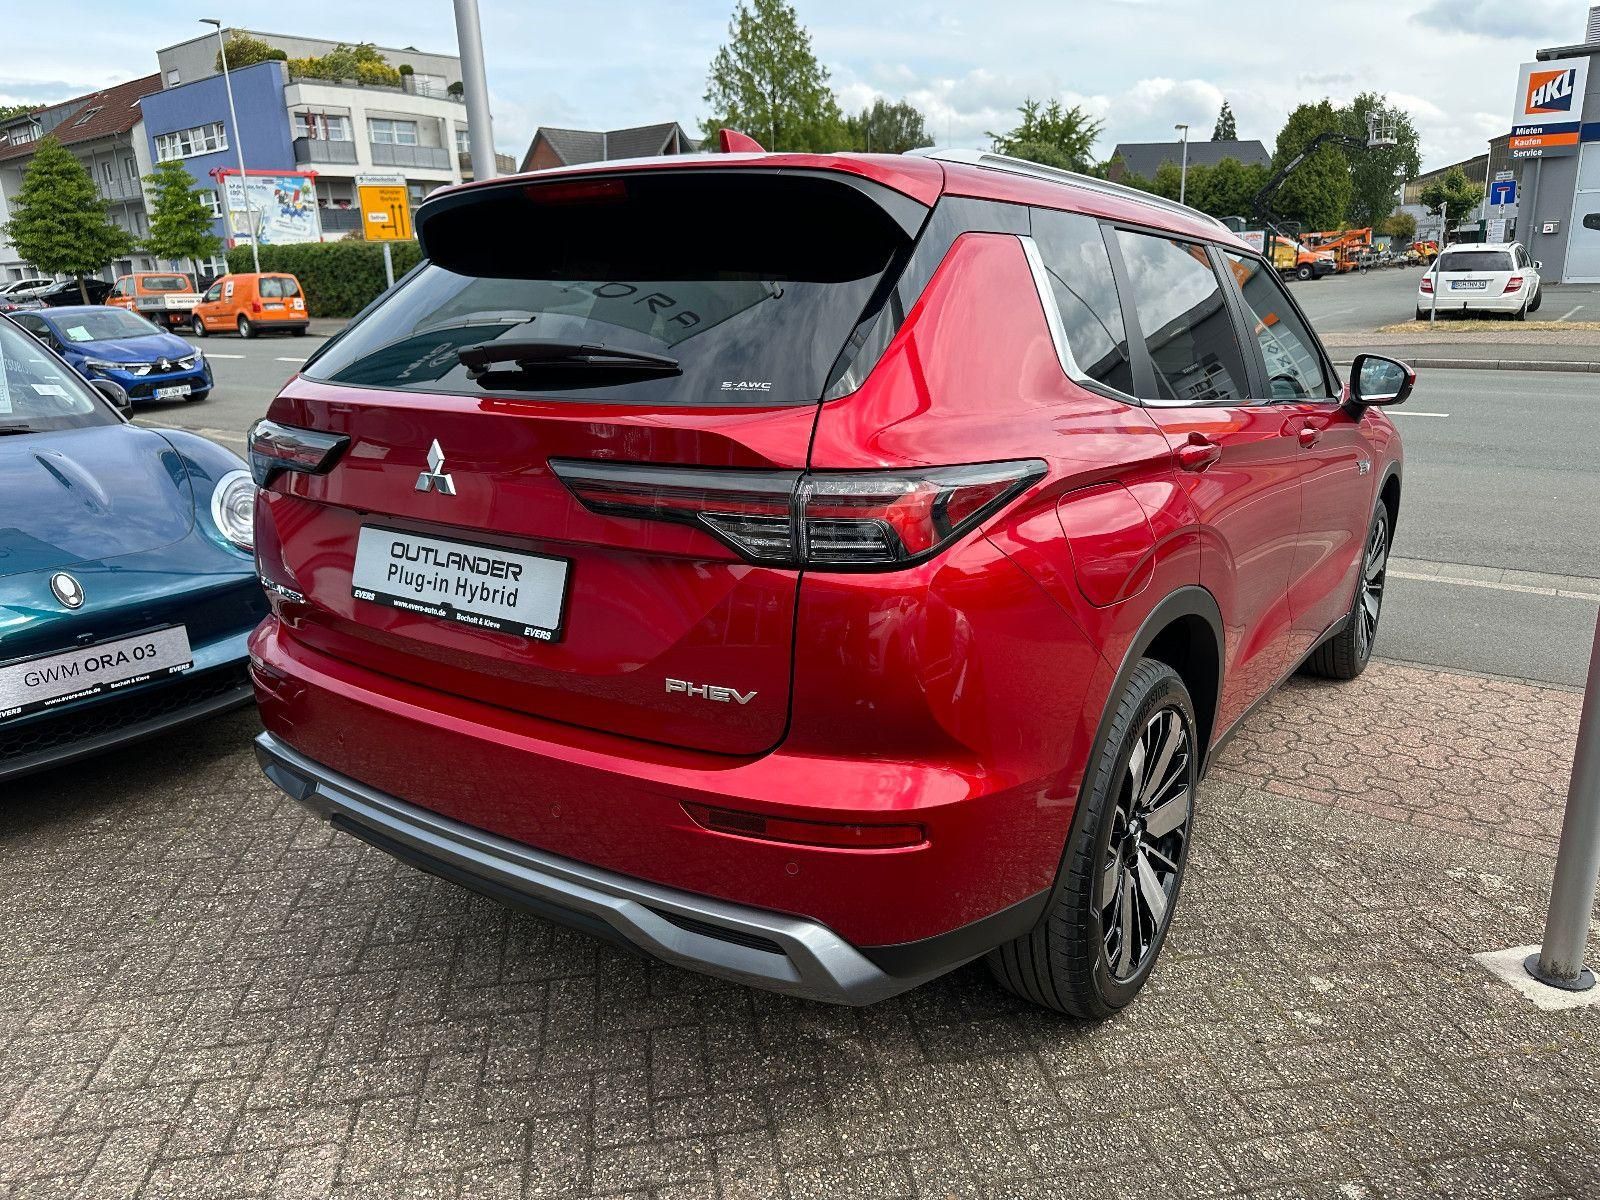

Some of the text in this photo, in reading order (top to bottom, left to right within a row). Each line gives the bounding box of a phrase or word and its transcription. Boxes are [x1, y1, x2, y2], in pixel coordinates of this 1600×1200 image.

[1530, 68, 1572, 108] HKL
[1514, 138, 1542, 147] Kaufen
[1516, 127, 1543, 136] Mieten
[1513, 148, 1543, 157] Service
[721, 381, 772, 389] S-AWC
[390, 541, 523, 582] OUTLANDER
[387, 563, 519, 608] Plug-in Hybrid
[354, 589, 552, 641] EVERS www.evers-auto.de Bocholt & Kleve EVERS
[24, 643, 157, 688] GWM ORA 03
[44, 687, 101, 706] www.evers-auto.de
[110, 678, 131, 689] Bocholt
[168, 662, 190, 674] EVERS
[665, 677, 758, 705] PHEV
